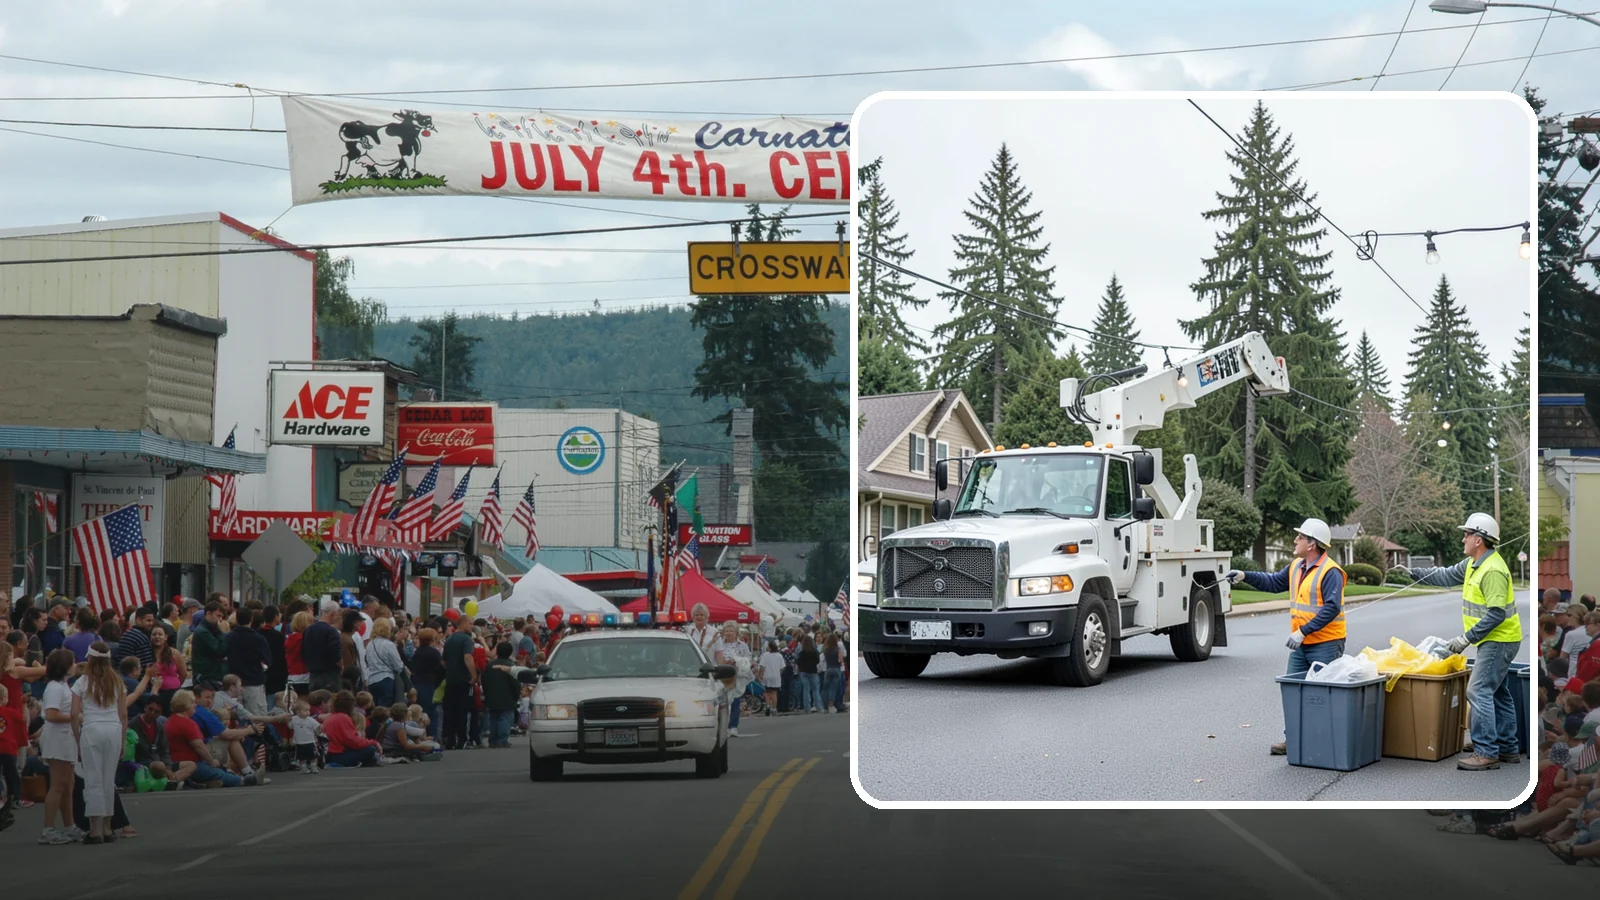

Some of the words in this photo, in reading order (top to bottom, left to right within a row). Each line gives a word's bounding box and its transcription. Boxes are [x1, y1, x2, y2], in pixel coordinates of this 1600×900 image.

[695, 121, 850, 150] Carnat
[481, 141, 605, 192] JULY
[632, 150, 746, 197] 4th.
[697, 254, 850, 280] CROSSWA
[283, 380, 373, 420] ACE
[406, 409, 452, 422] CEDAR
[283, 421, 371, 436] Hardware
[416, 427, 476, 447] Coca-Cola
[353, 466, 386, 480] Simpl
[95, 485, 124, 494] Vincent
[126, 486, 136, 495] de
[138, 486, 155, 495] Paul
[688, 526, 741, 535] CRNATION
[699, 535, 730, 543] GLASS
